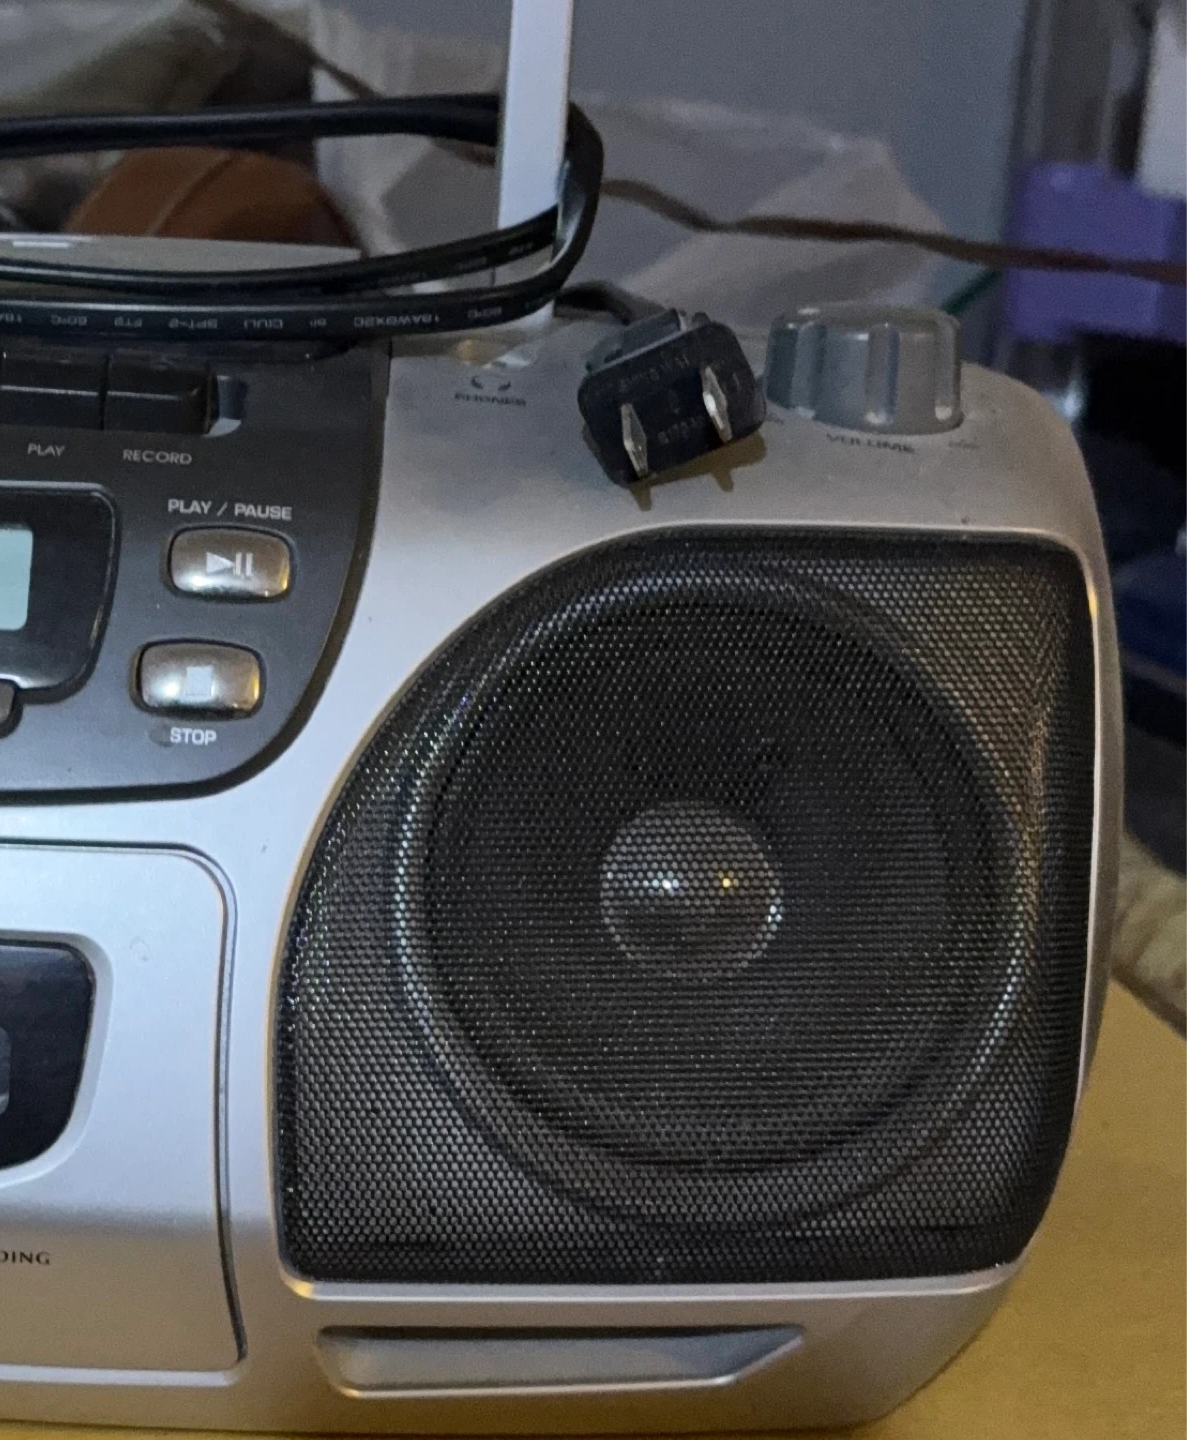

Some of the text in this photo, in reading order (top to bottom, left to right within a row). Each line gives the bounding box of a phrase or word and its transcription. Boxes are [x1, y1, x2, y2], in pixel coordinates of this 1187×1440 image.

[28, 443, 65, 458] PLAY
[123, 449, 192, 465] RECORD
[168, 499, 211, 516] PLAY
[234, 503, 293, 521] PAUSE
[169, 728, 217, 746] STOP
